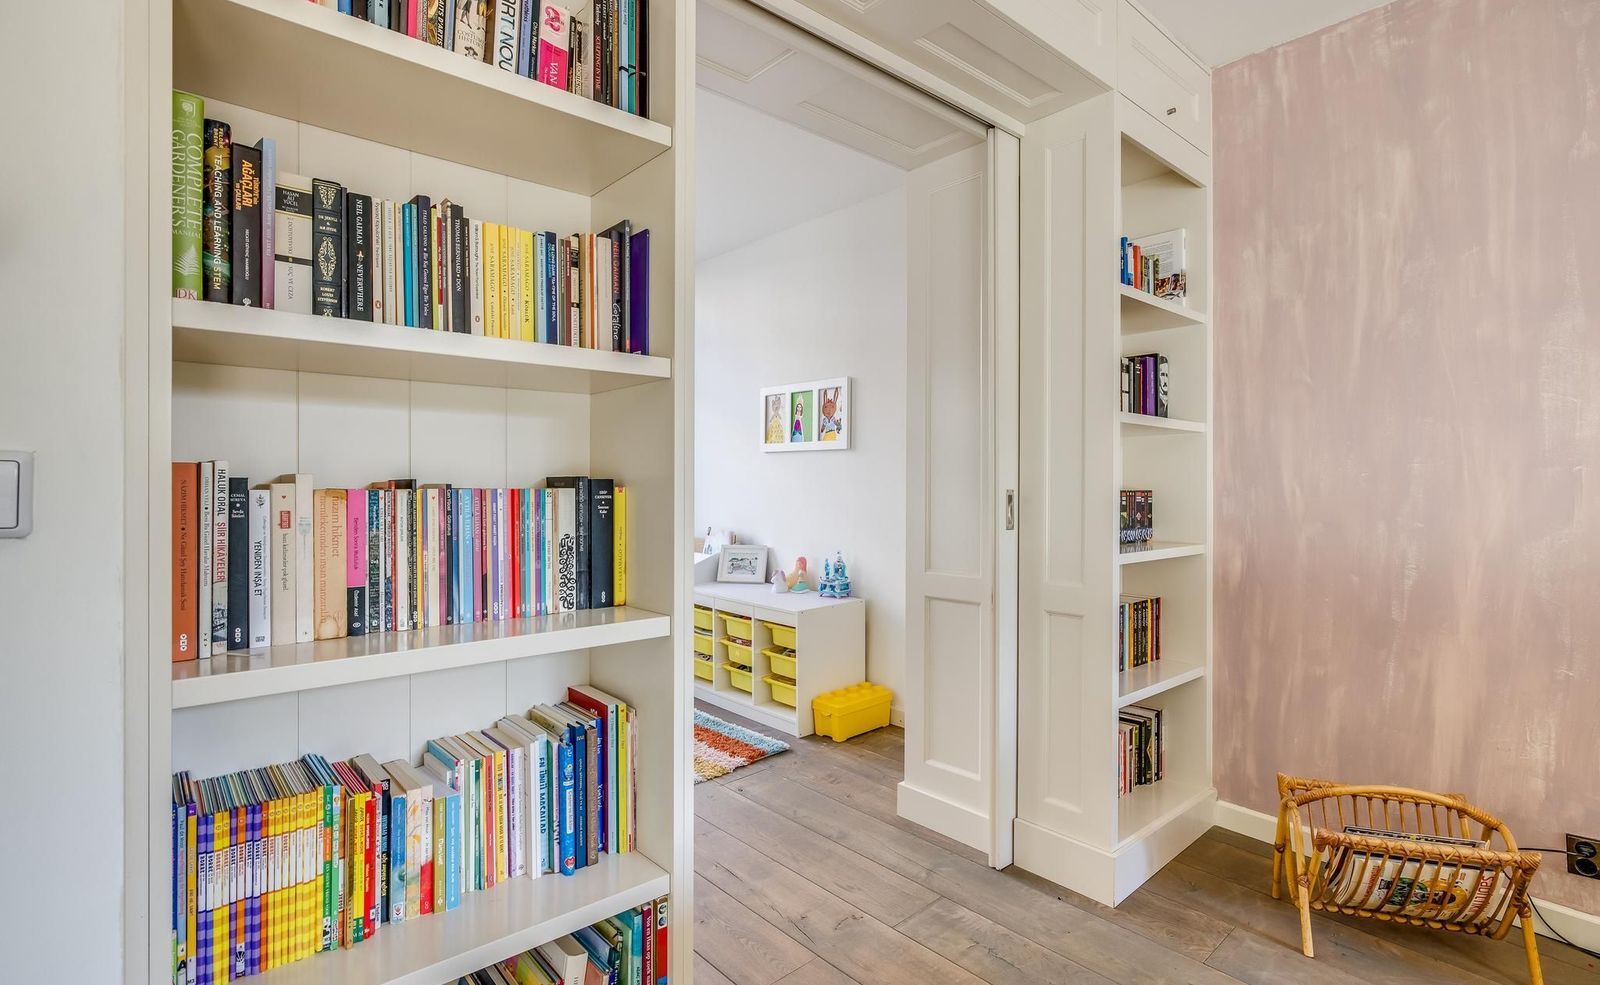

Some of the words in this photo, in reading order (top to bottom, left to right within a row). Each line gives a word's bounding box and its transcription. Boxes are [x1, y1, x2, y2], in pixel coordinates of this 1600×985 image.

[499, 31, 514, 73] NOU
[550, 62, 558, 84] VAN
[172, 130, 187, 229] GARDENER'S
[187, 133, 203, 230] COMPLETE
[214, 154, 222, 198] TEACHING
[240, 160, 254, 207] AĞAÇLARI
[214, 199, 222, 218] AND
[214, 220, 222, 264] LEARNING
[214, 266, 222, 290] STEM
[176, 288, 199, 300] DK
[612, 303, 622, 341] Coraline
[217, 469, 226, 495] HALUK
[217, 496, 226, 517] ORAL
[180, 532, 187, 541] Ne
[216, 522, 227, 538] ŞİİR
[331, 525, 343, 557] hikmet
[254, 540, 263, 571] YENİDEN
[180, 599, 188, 611] Seni
[254, 589, 263, 597] ET
[353, 590, 361, 607] Özdemir
[647, 927, 652, 936] en
